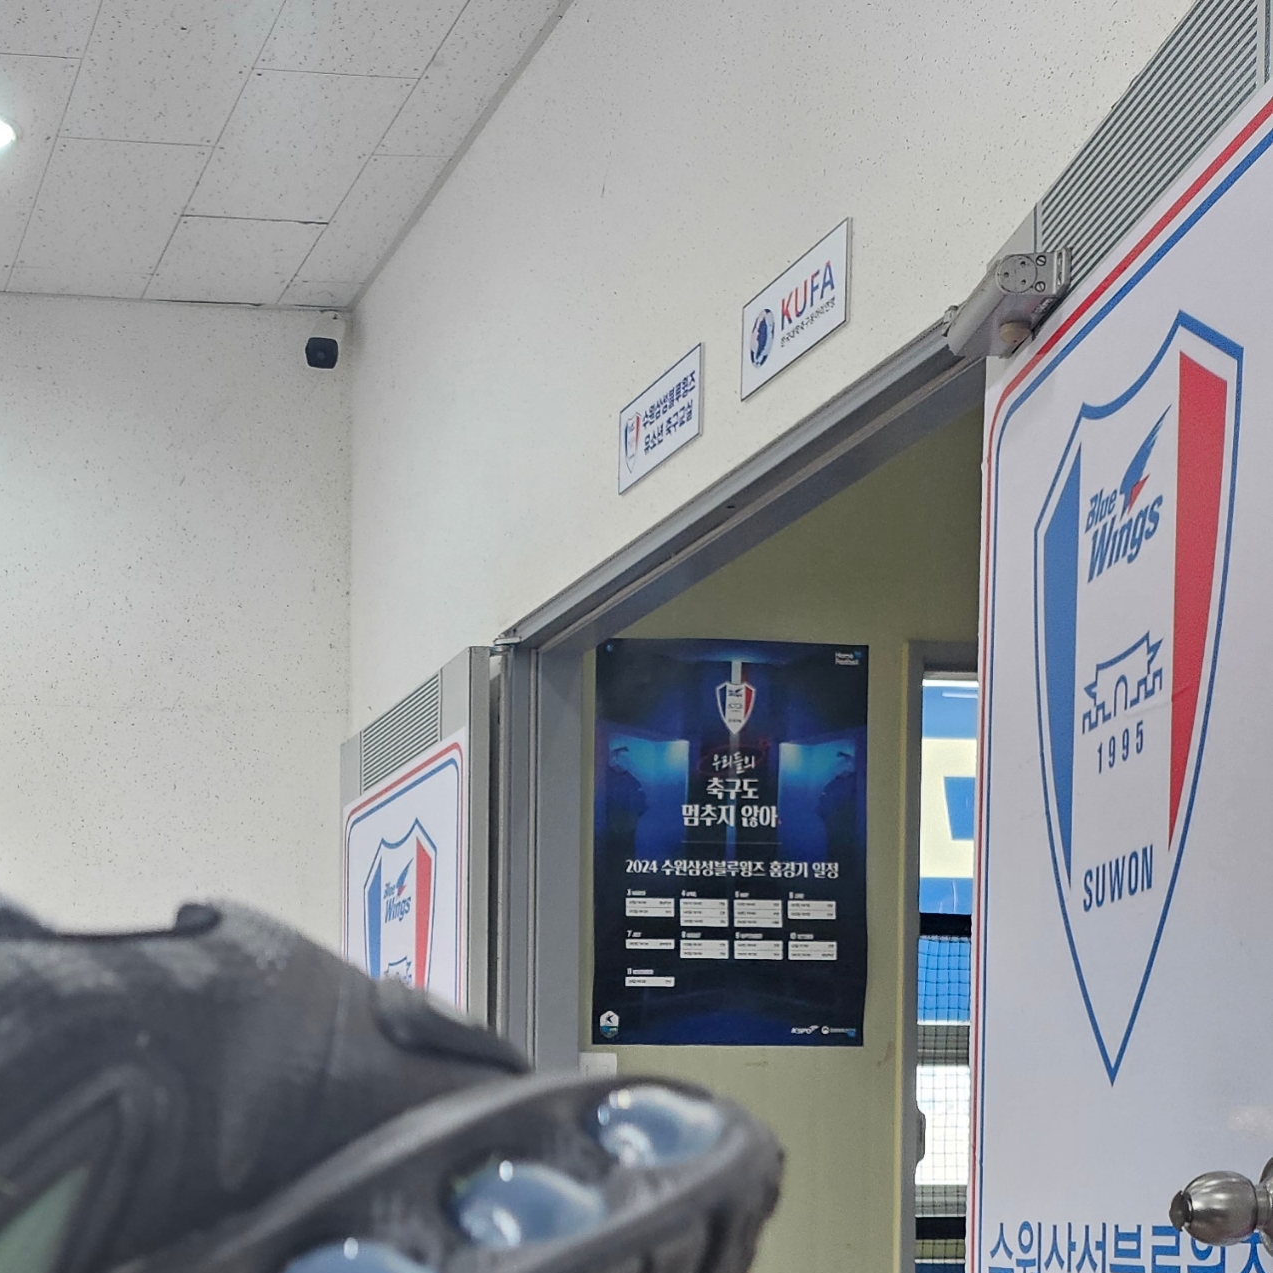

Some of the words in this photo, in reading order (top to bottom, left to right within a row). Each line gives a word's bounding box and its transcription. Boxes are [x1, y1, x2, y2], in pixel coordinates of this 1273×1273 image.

[780, 260, 835, 331] KUFA
[643, 421, 664, 455] 유소년
[665, 399, 694, 435] 축구교실
[1085, 487, 1117, 534] Blue
[1087, 494, 1164, 584] Wings
[711, 751, 756, 774] 우리들의
[1096, 734, 1145, 775] 1995
[705, 778, 759, 800] 축구도
[681, 804, 735, 827] 멈추지
[626, 860, 658, 874] 2024
[661, 860, 766, 877] 수원삼성블루윙즈
[769, 862, 808, 878] 홈경기
[812, 862, 840, 879] 일정
[1083, 843, 1155, 912] SUWON
[384, 896, 412, 923] Wings
